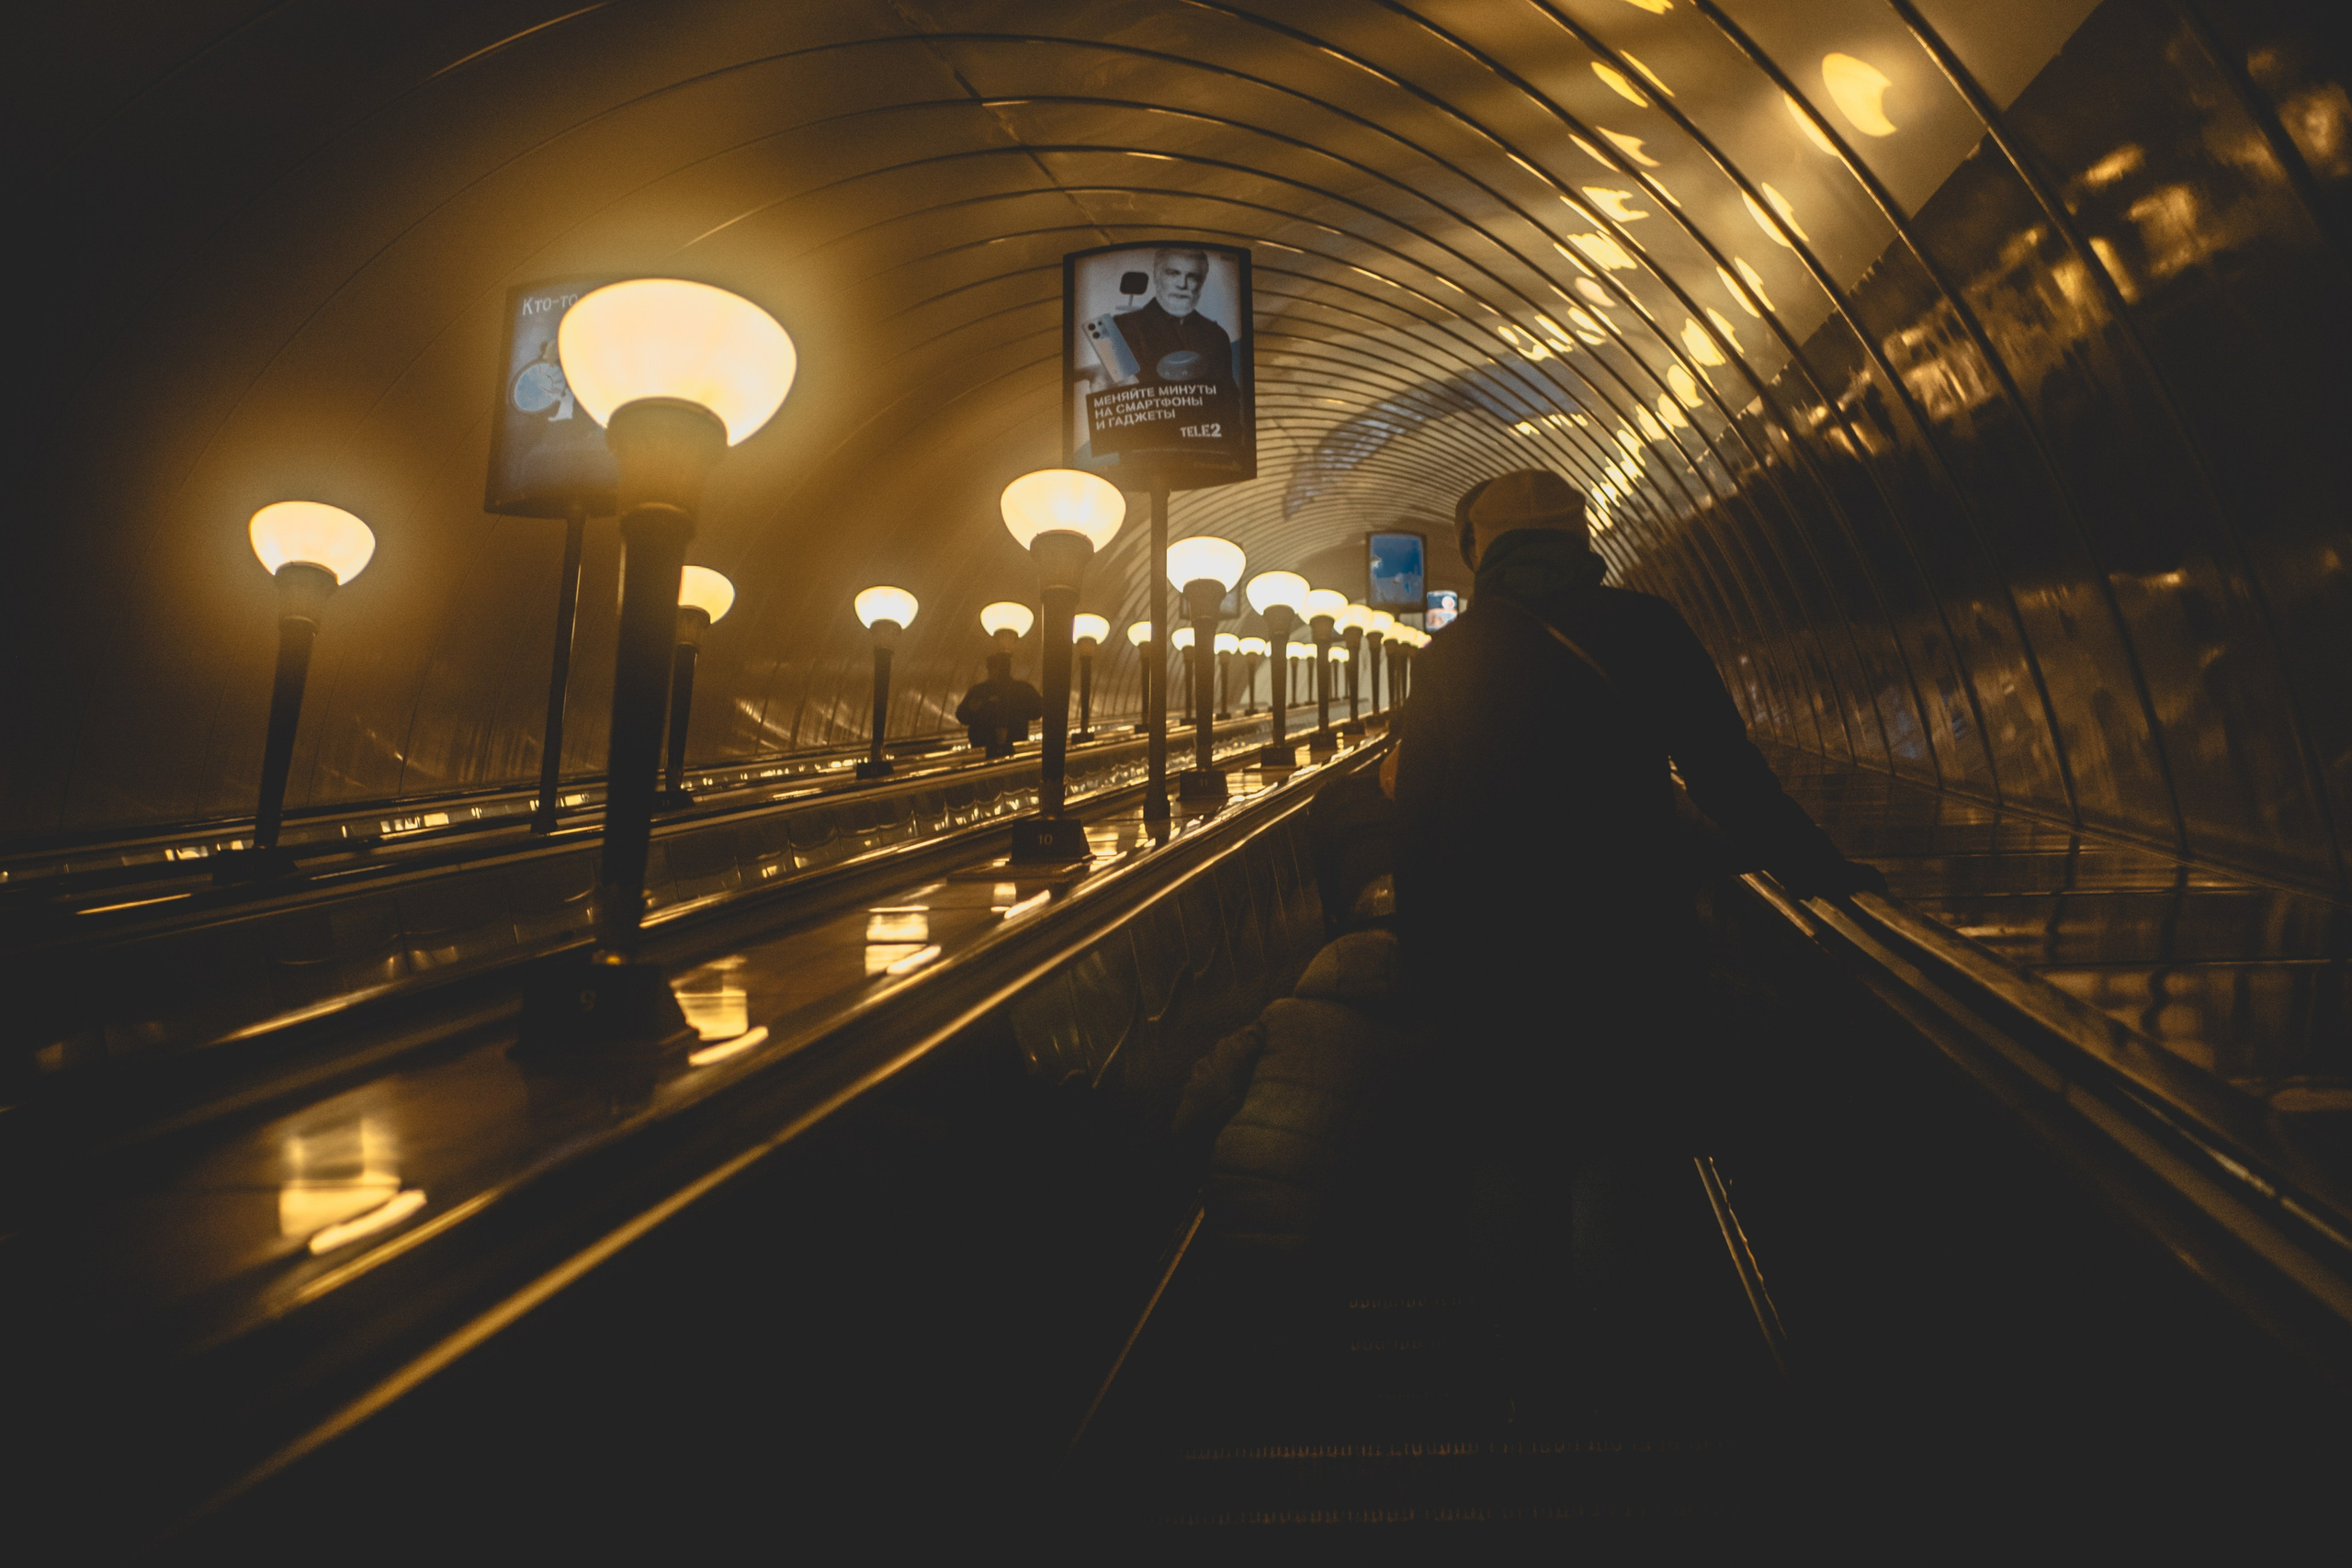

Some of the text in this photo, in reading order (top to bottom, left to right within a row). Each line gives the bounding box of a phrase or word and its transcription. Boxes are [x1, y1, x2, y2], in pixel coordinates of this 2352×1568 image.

[1093, 385, 1216, 408] МЕНЯЙТЕ МИНУТЫ
[1094, 396, 1203, 420] НА СМАРТФОНЫ
[1096, 409, 1176, 431] И ГАДЖЕТЫ
[1180, 423, 1222, 437] TELE2
[1037, 833, 1054, 845] 10
